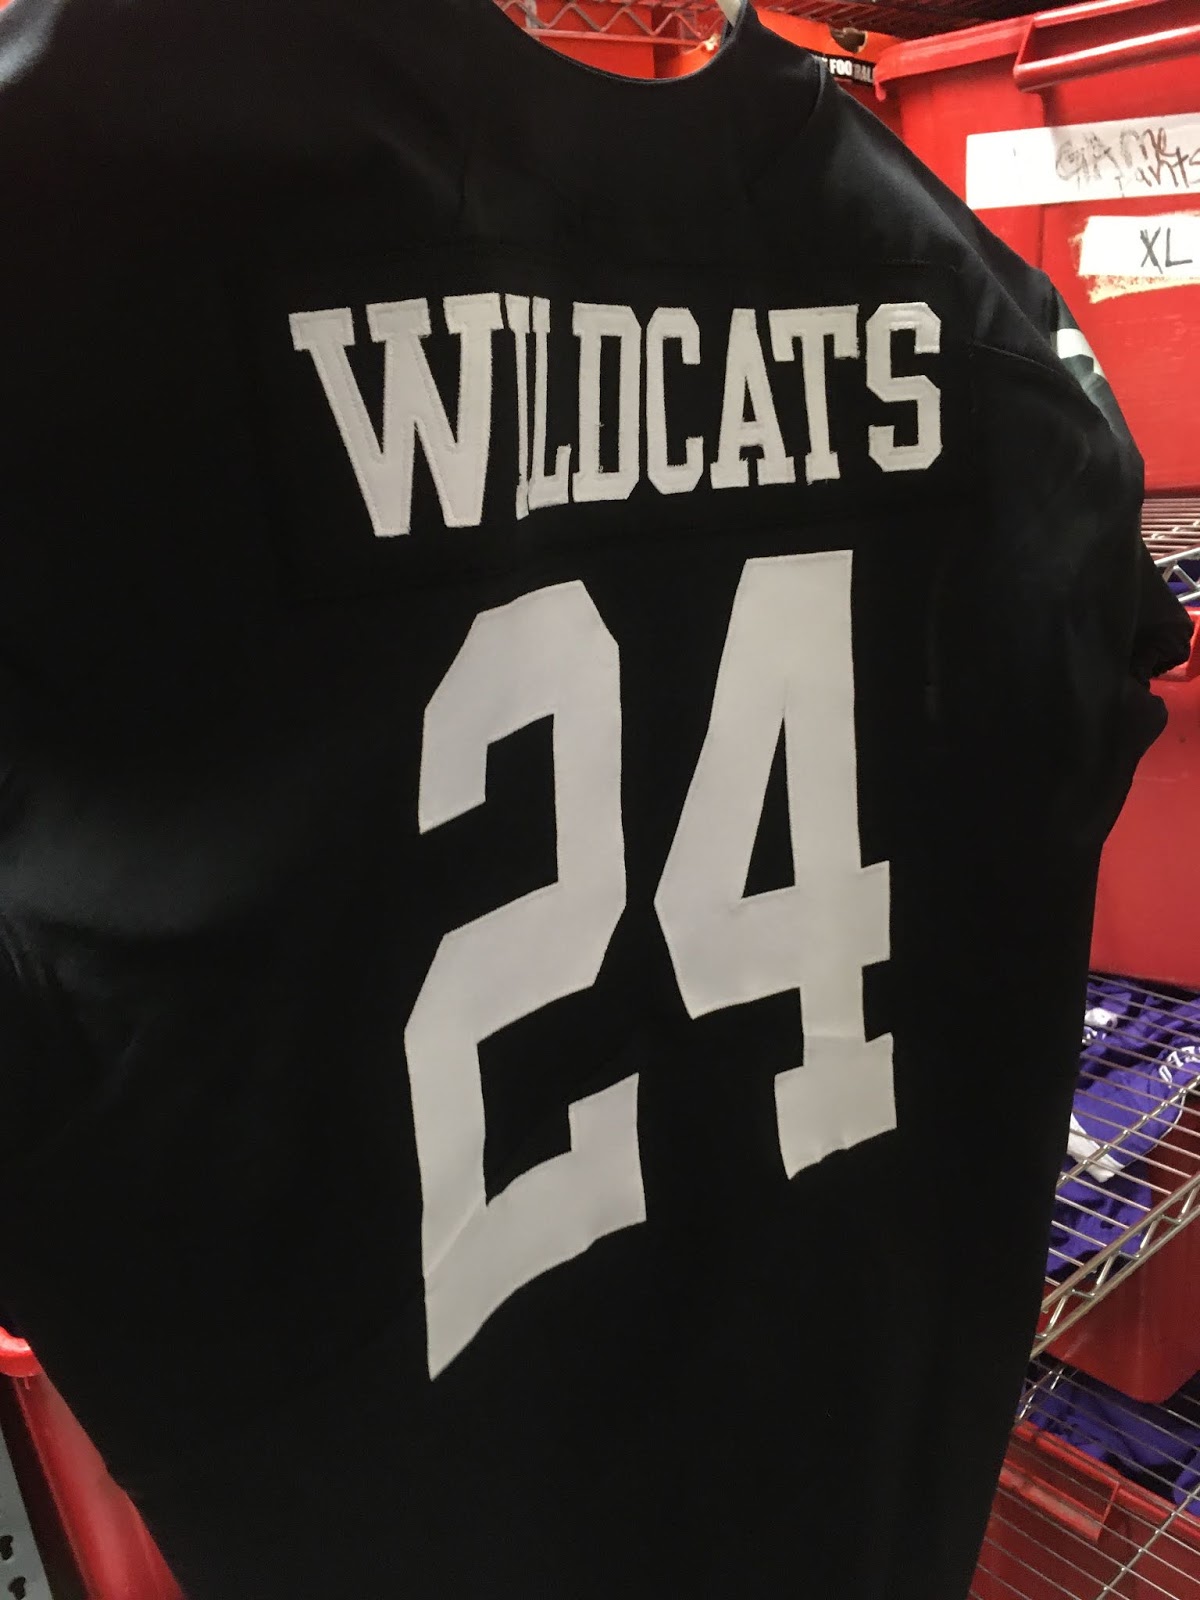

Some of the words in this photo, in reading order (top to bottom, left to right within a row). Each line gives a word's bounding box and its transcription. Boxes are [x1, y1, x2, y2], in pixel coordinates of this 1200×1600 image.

[1140, 226, 1193, 275] XL
[288, 291, 943, 538] WILDCATS
[404, 549, 897, 1380] 24
